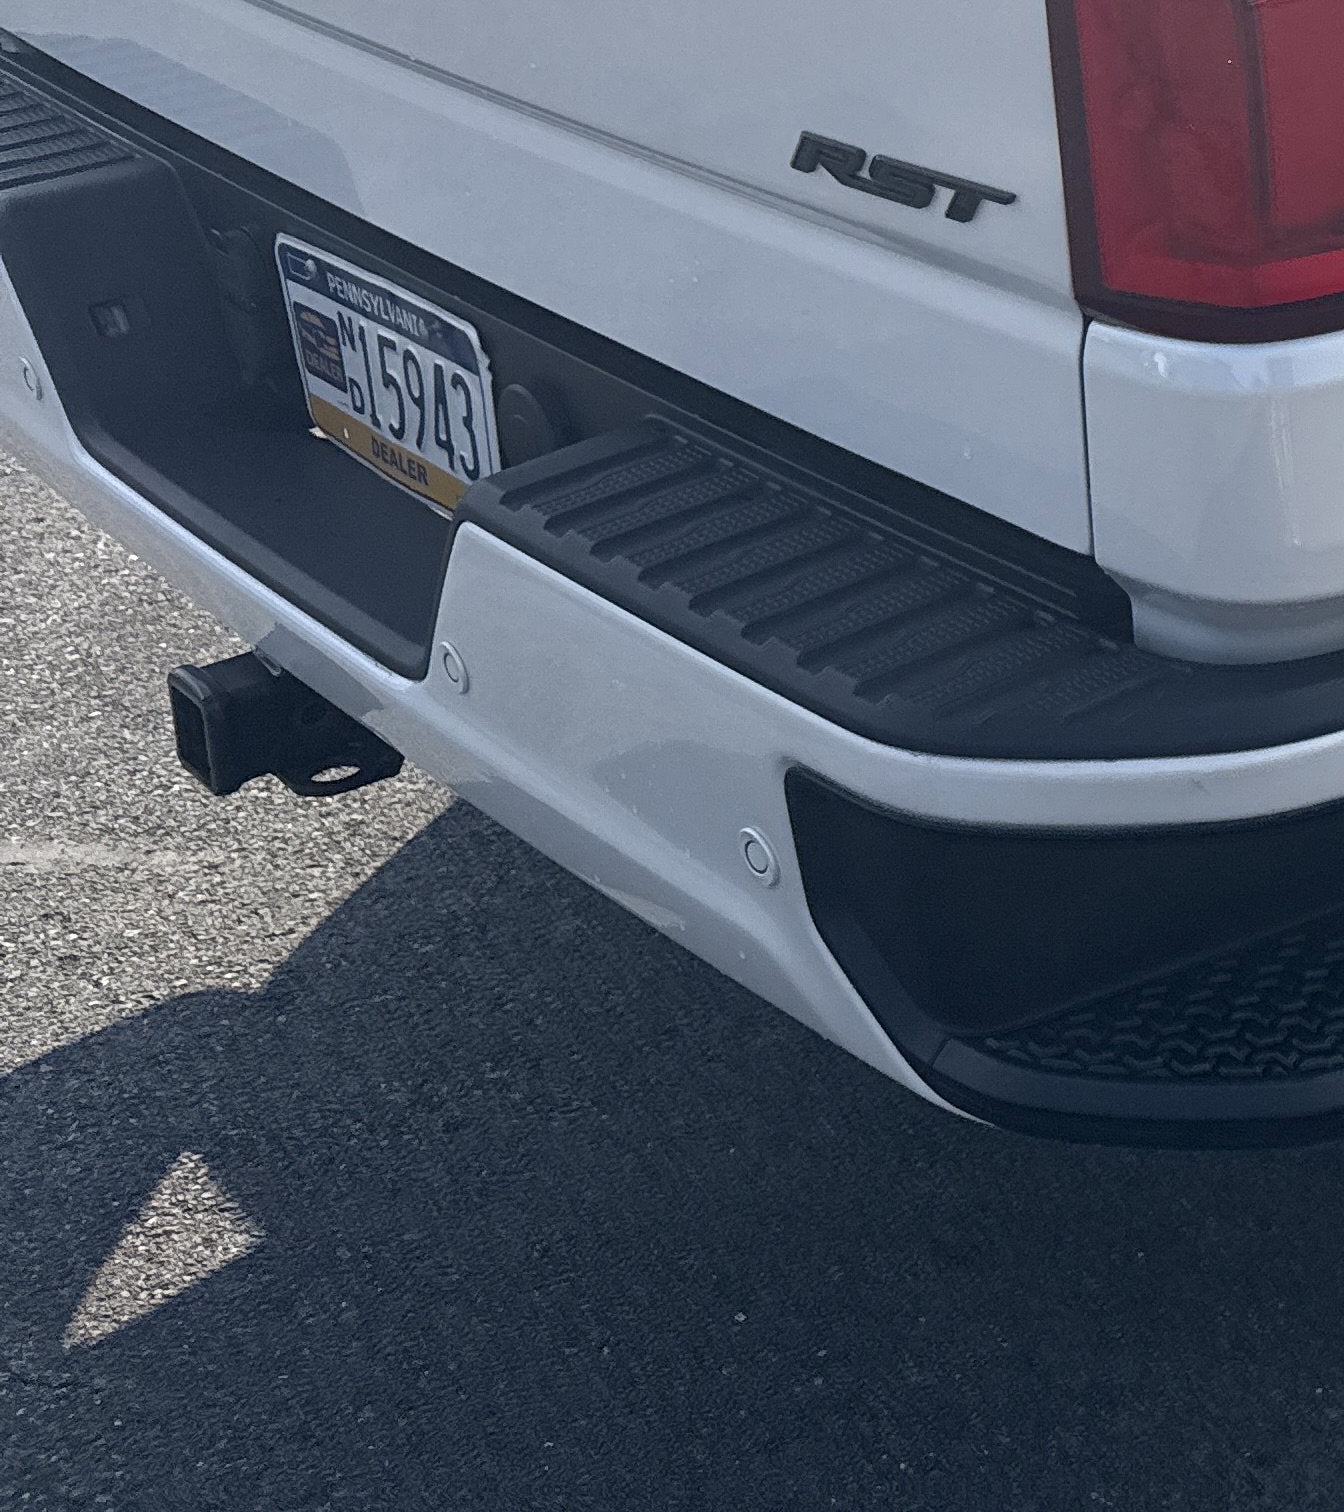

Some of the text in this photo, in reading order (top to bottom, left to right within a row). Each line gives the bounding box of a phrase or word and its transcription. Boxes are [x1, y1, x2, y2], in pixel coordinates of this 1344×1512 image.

[790, 130, 1017, 223] RST
[326, 271, 429, 337] PENNSYLVANIA
[358, 325, 480, 481] 15943
[371, 435, 429, 486] DEALER
